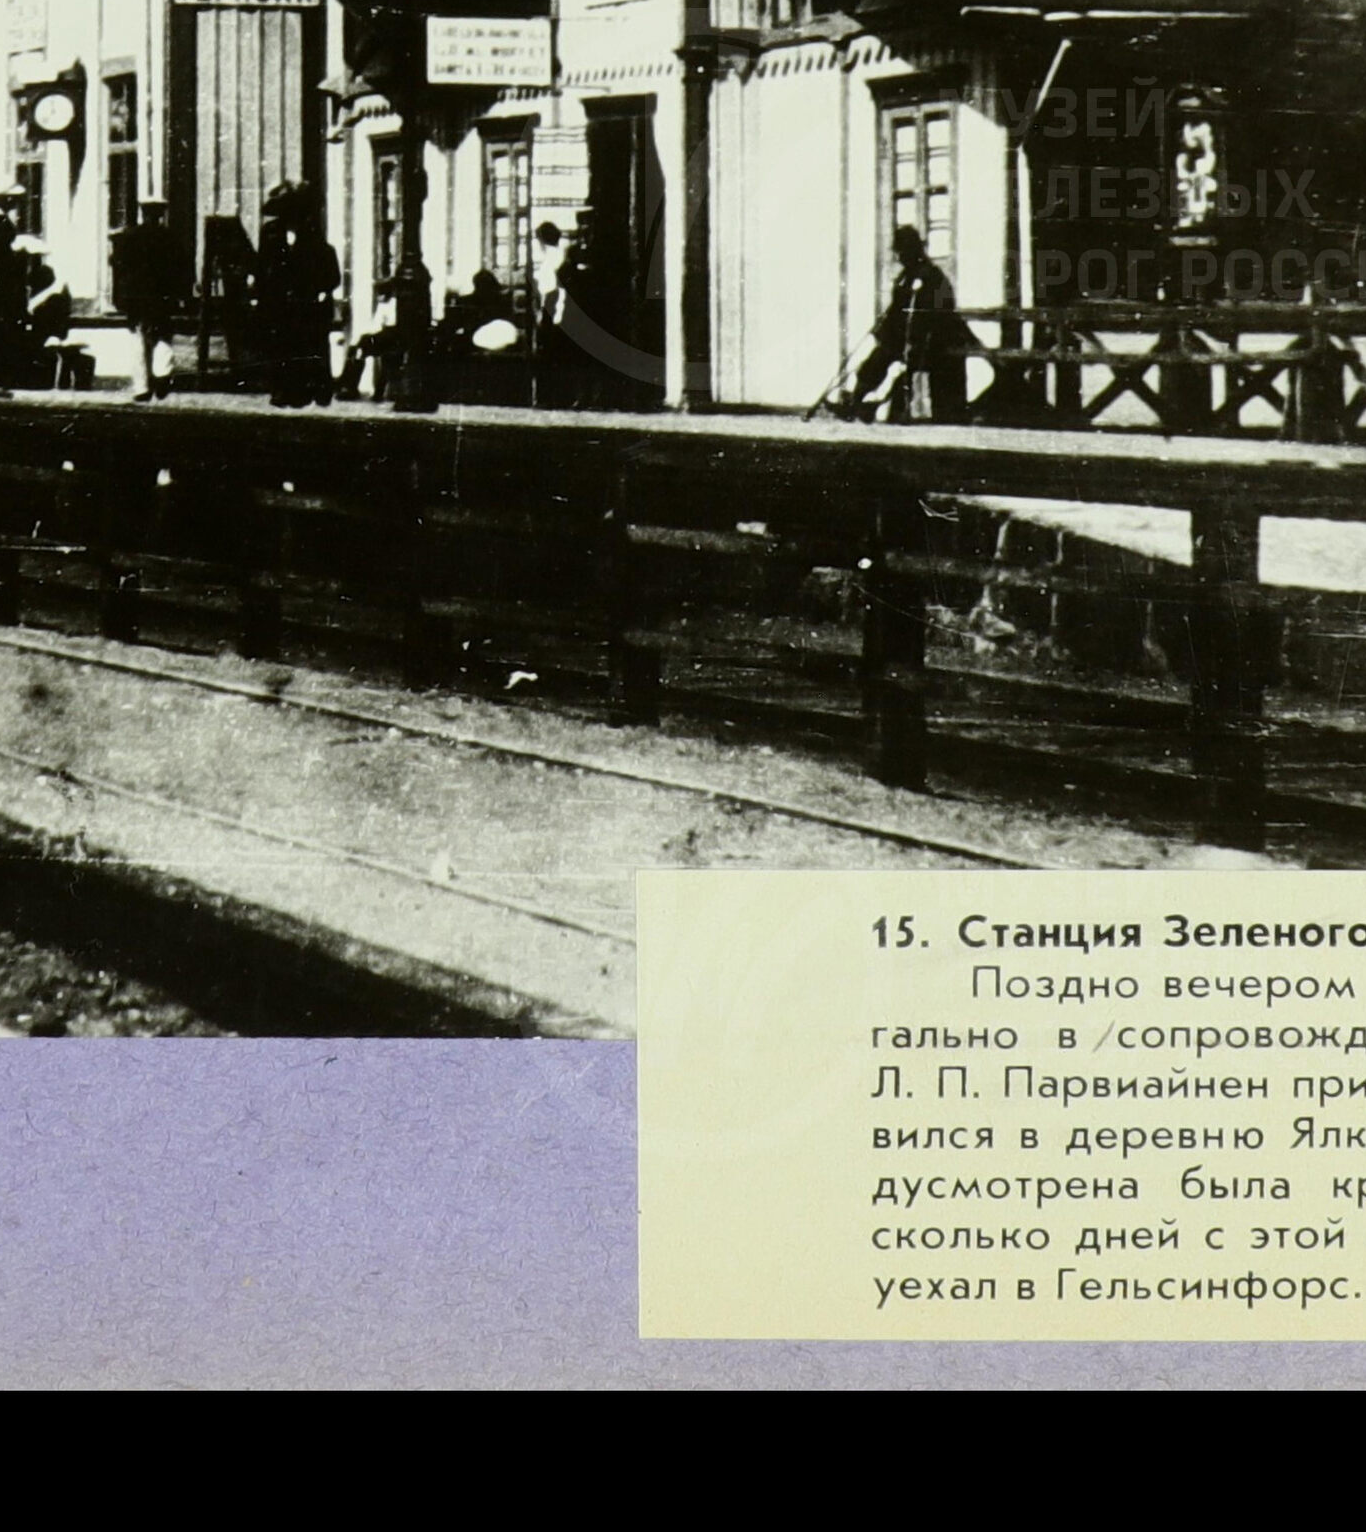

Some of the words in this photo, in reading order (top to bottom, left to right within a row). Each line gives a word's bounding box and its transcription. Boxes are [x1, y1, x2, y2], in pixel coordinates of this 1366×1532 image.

[872, 915, 929, 949] 15.
[958, 914, 1142, 955] Станция
[972, 965, 1139, 1005] Поздно
[1164, 976, 1356, 1009] вечером
[871, 1026, 1018, 1050] гально
[1058, 1027, 1077, 1049] в
[870, 1065, 913, 1099] Л.
[938, 1065, 980, 1099] П.
[1004, 1065, 1268, 1108] Парвиайнен
[872, 1126, 994, 1150] вился
[1020, 1127, 1039, 1149] в
[1065, 1127, 1264, 1160] деревню
[871, 1176, 1139, 1209] дусмотрена
[1180, 1164, 1290, 1200] была
[871, 1227, 1050, 1251] сколько
[1074, 1218, 1179, 1256] дней
[1204, 1227, 1224, 1251] с
[1250, 1217, 1345, 1250] этой
[873, 1277, 996, 1310] уехал
[1016, 1278, 1036, 1301] в
[1057, 1267, 1361, 1310] Гельсинфорс.
